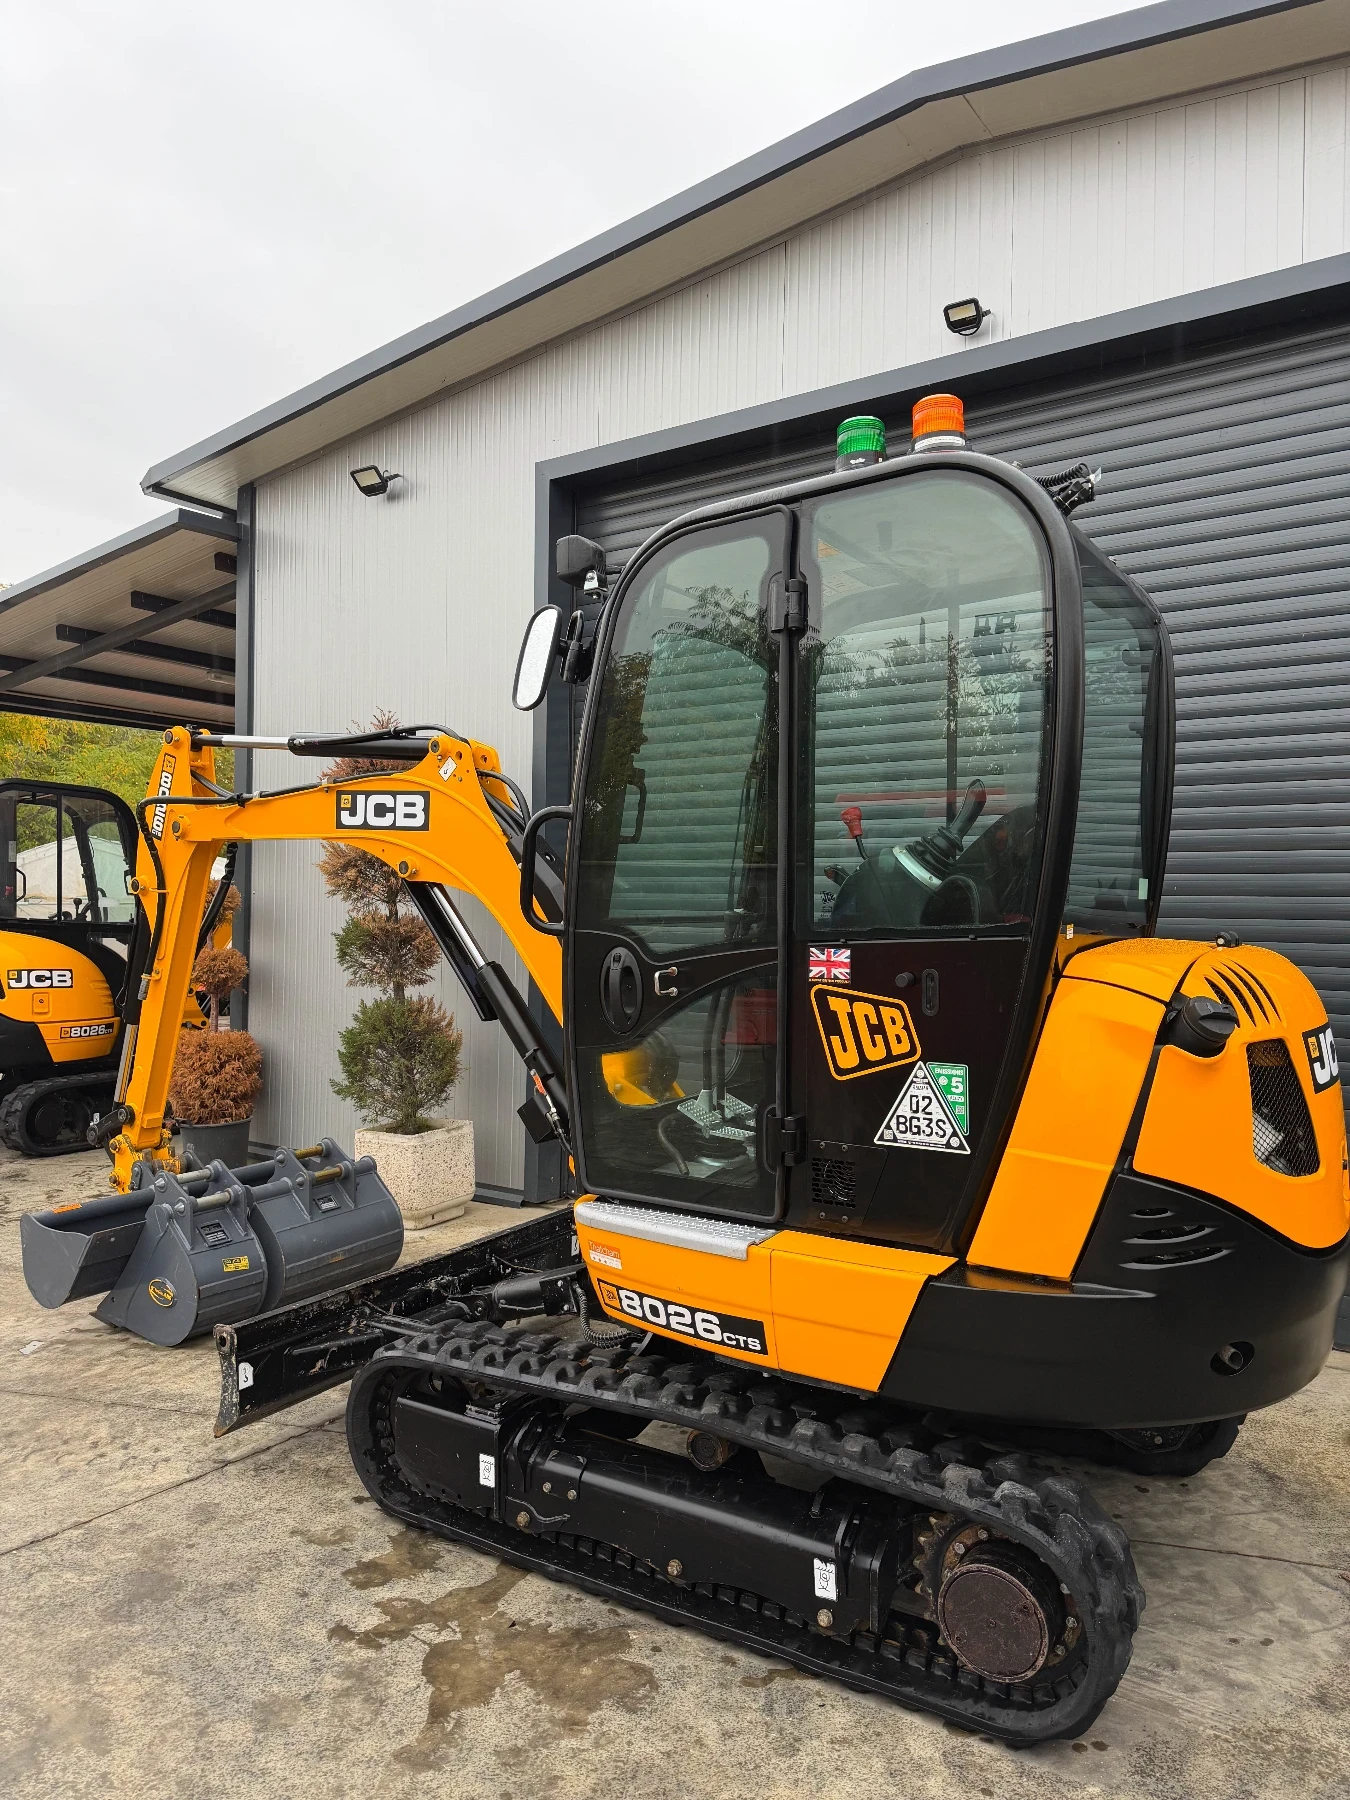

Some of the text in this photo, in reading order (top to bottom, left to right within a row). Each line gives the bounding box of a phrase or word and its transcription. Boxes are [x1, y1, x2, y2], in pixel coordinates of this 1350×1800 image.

[341, 794, 425, 827] JCB
[8, 970, 72, 988] JCB
[827, 995, 911, 1069] JCB
[1313, 1028, 1338, 1084] JC
[951, 1076, 964, 1094] 5
[895, 1114, 947, 1139] BG3S
[589, 1241, 620, 1259] Thatcham
